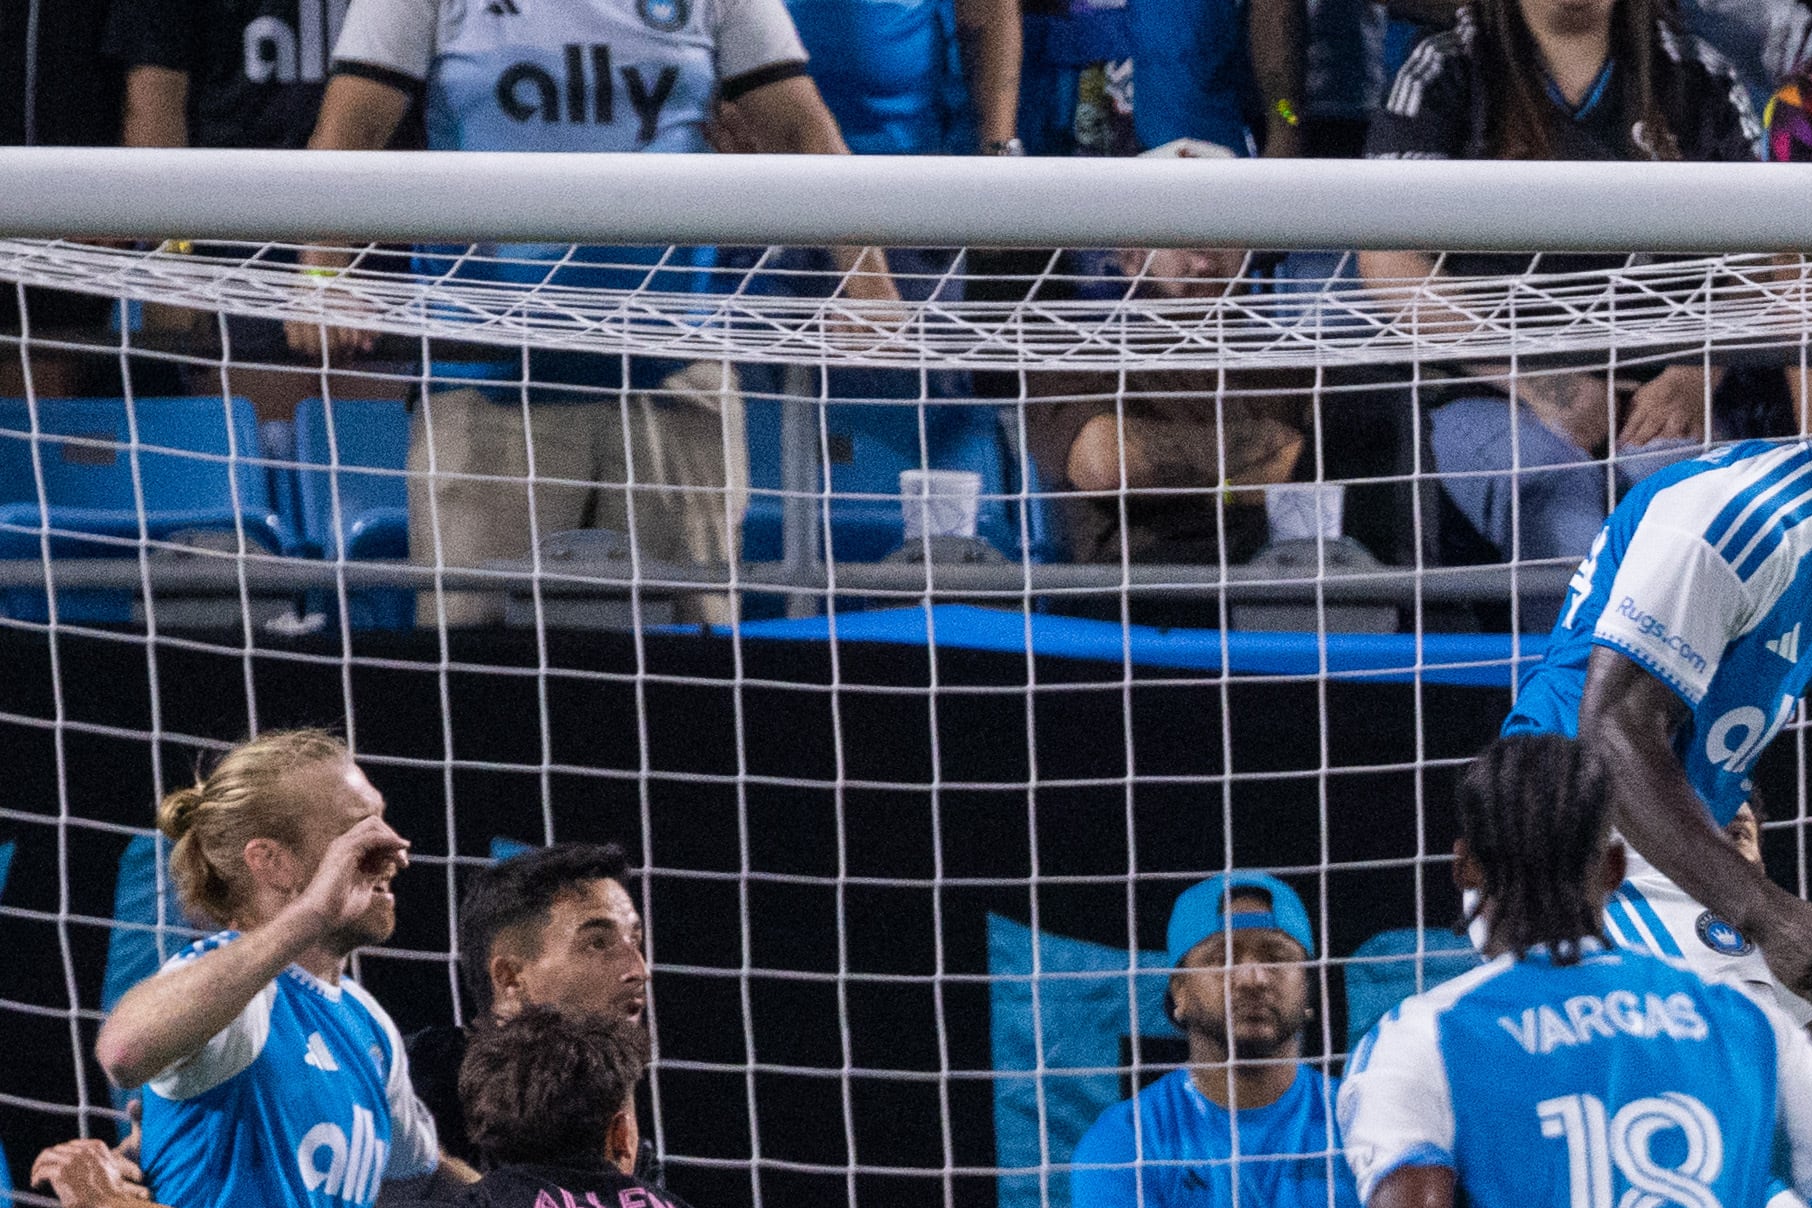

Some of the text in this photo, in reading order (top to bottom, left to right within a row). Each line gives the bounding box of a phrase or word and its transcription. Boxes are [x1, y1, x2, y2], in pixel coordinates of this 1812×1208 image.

[500, 43, 679, 143] ally
[1616, 596, 1707, 675] Rugs.com
[1498, 990, 1708, 1055] VARGAS
